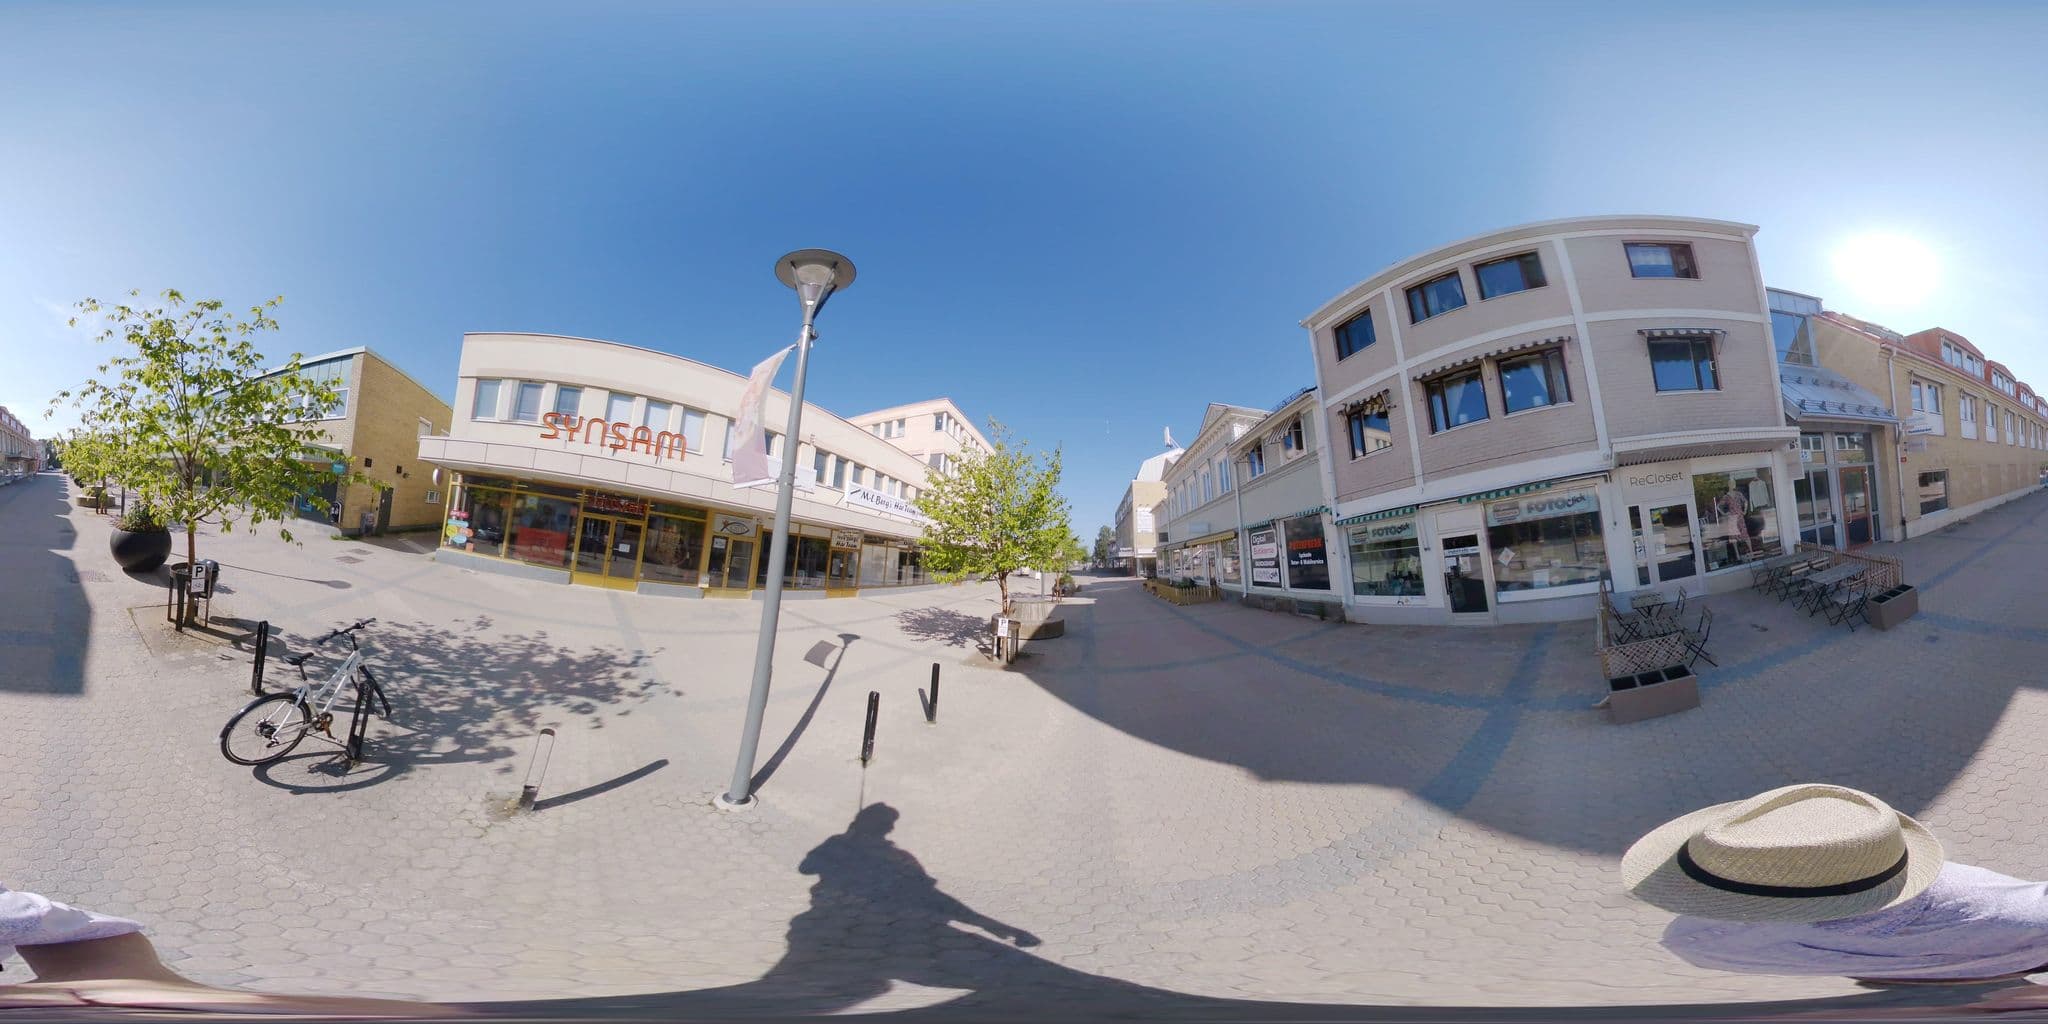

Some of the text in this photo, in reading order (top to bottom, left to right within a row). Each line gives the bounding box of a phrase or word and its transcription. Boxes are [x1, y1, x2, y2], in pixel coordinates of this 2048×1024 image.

[540, 412, 687, 462] SYNSAM
[1630, 472, 1683, 487] ReCloset
[195, 566, 204, 577] P
